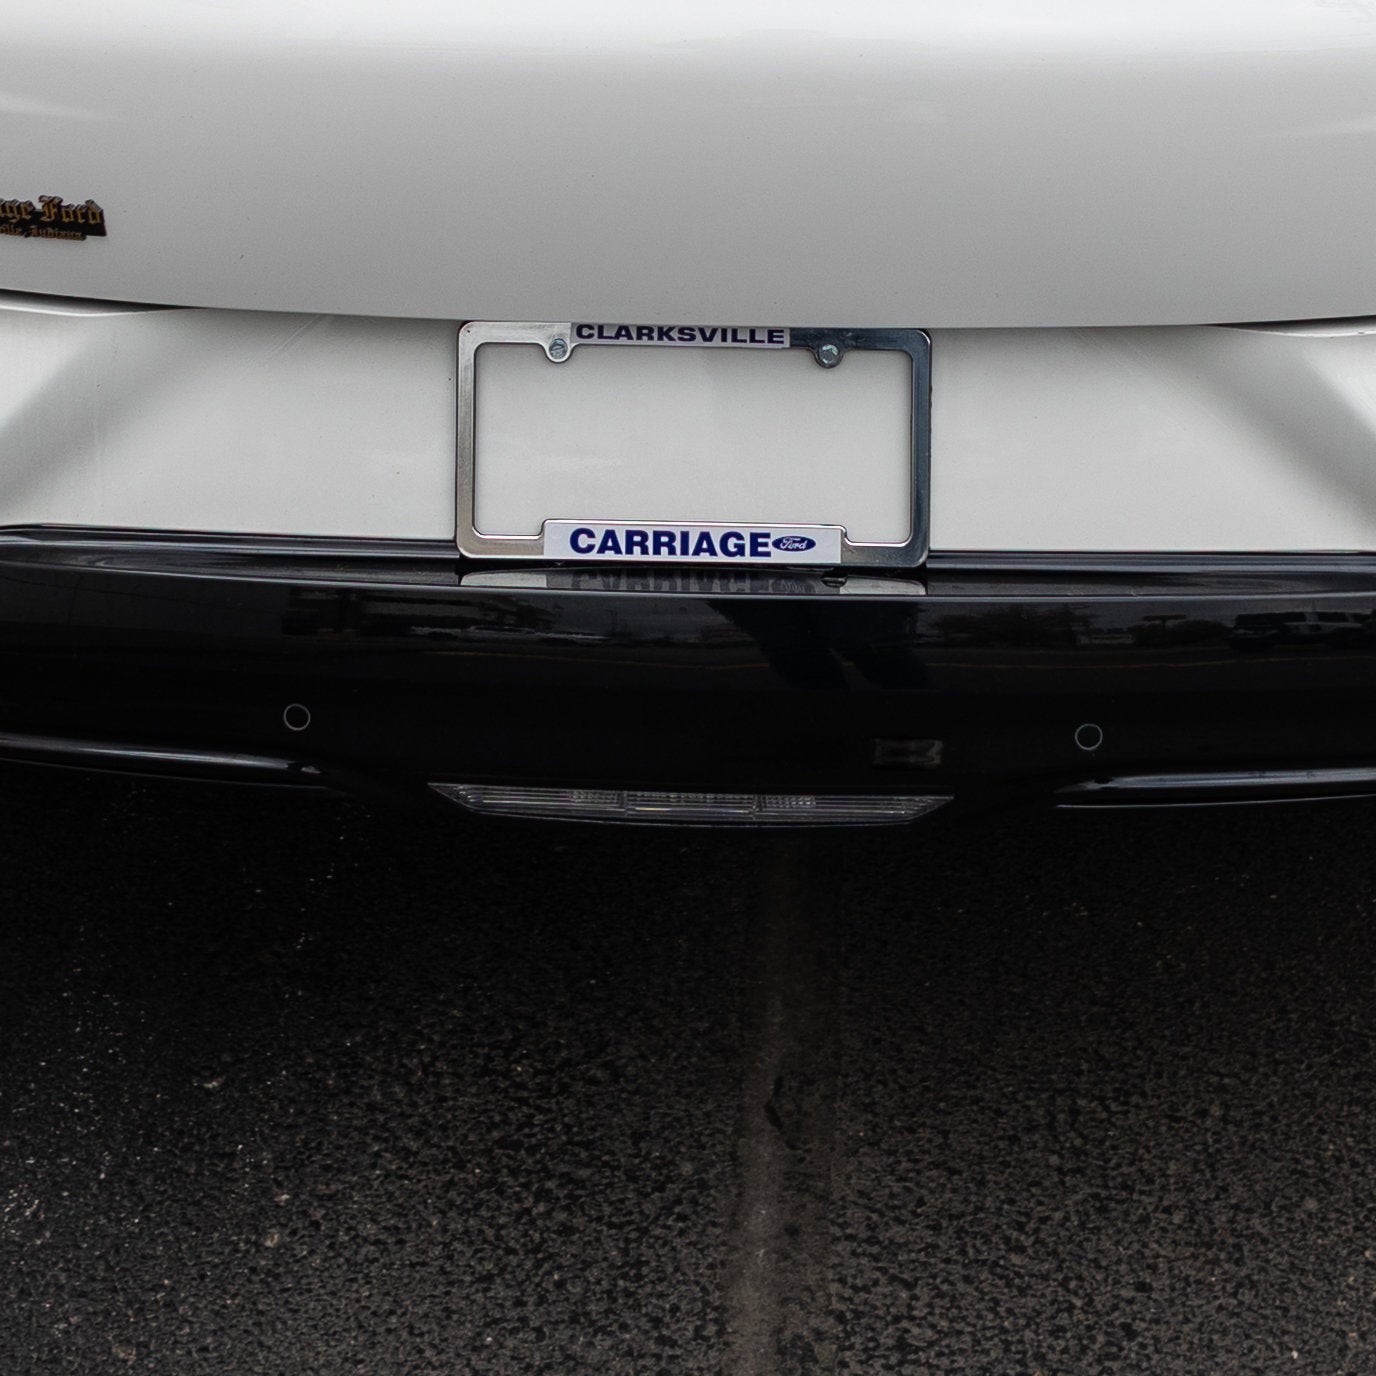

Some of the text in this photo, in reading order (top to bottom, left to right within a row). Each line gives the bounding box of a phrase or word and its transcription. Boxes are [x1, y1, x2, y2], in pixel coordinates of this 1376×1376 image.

[39, 195, 104, 225] Ford
[576, 324, 784, 344] CLARKSVILLE
[570, 528, 771, 557] CARRIAGE
